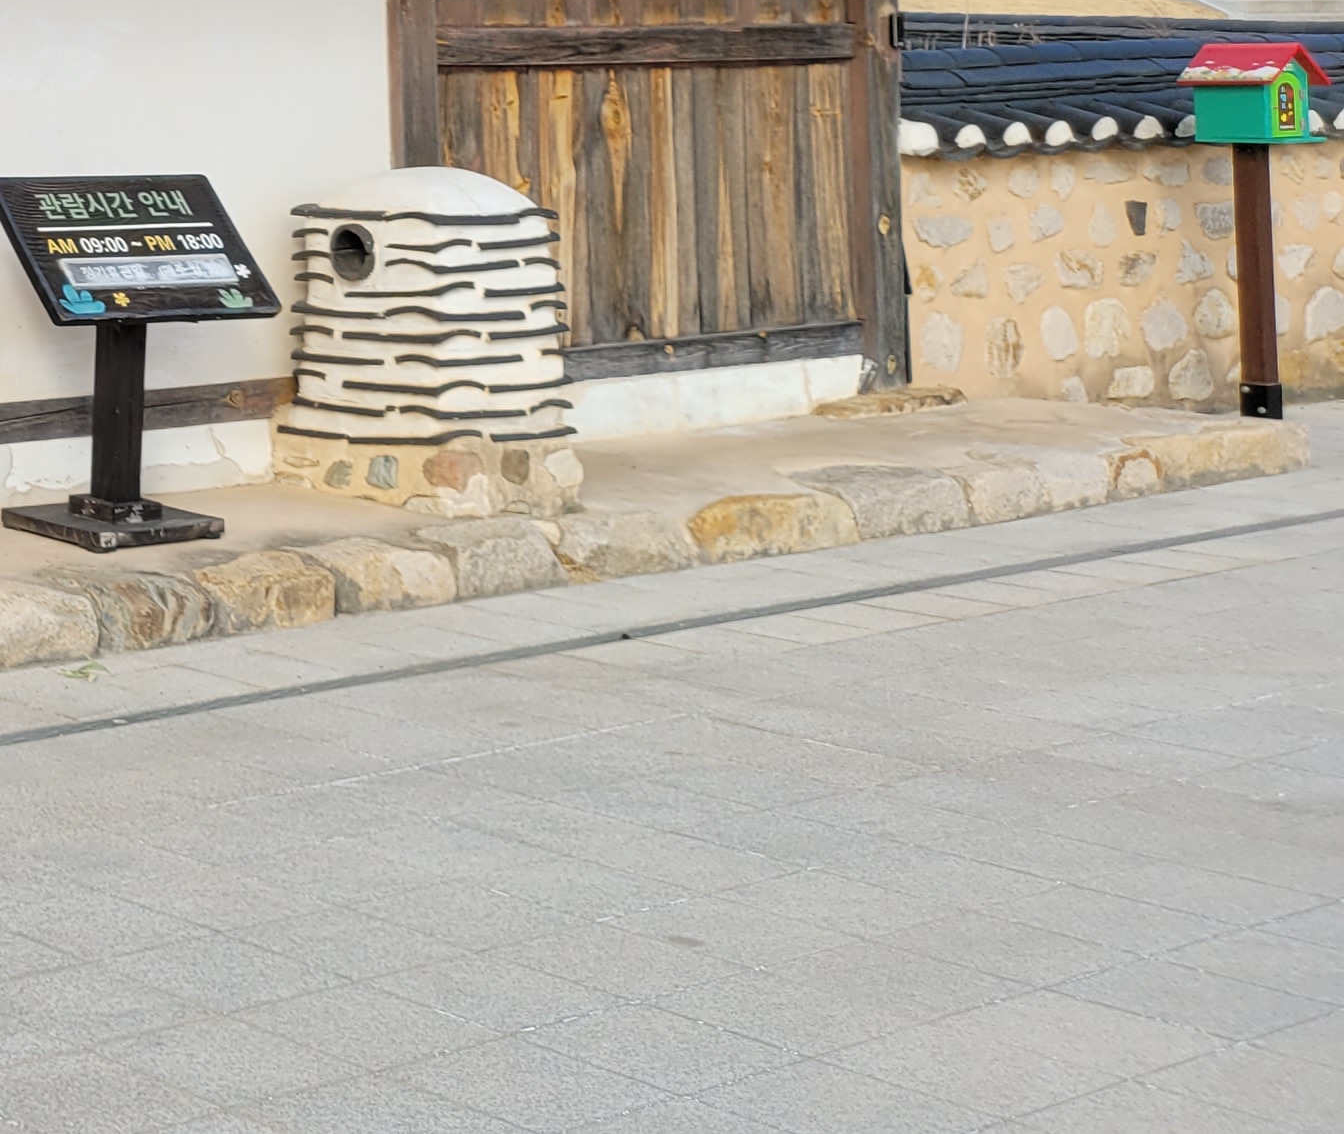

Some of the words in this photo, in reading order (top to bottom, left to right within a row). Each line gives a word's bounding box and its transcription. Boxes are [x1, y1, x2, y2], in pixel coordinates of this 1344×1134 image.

[33, 191, 135, 220] 관람시간
[137, 189, 194, 217] 안내
[47, 237, 80, 254] AM
[81, 236, 130, 254] 09:00
[143, 234, 177, 252] PM
[177, 232, 224, 251] 18:00
